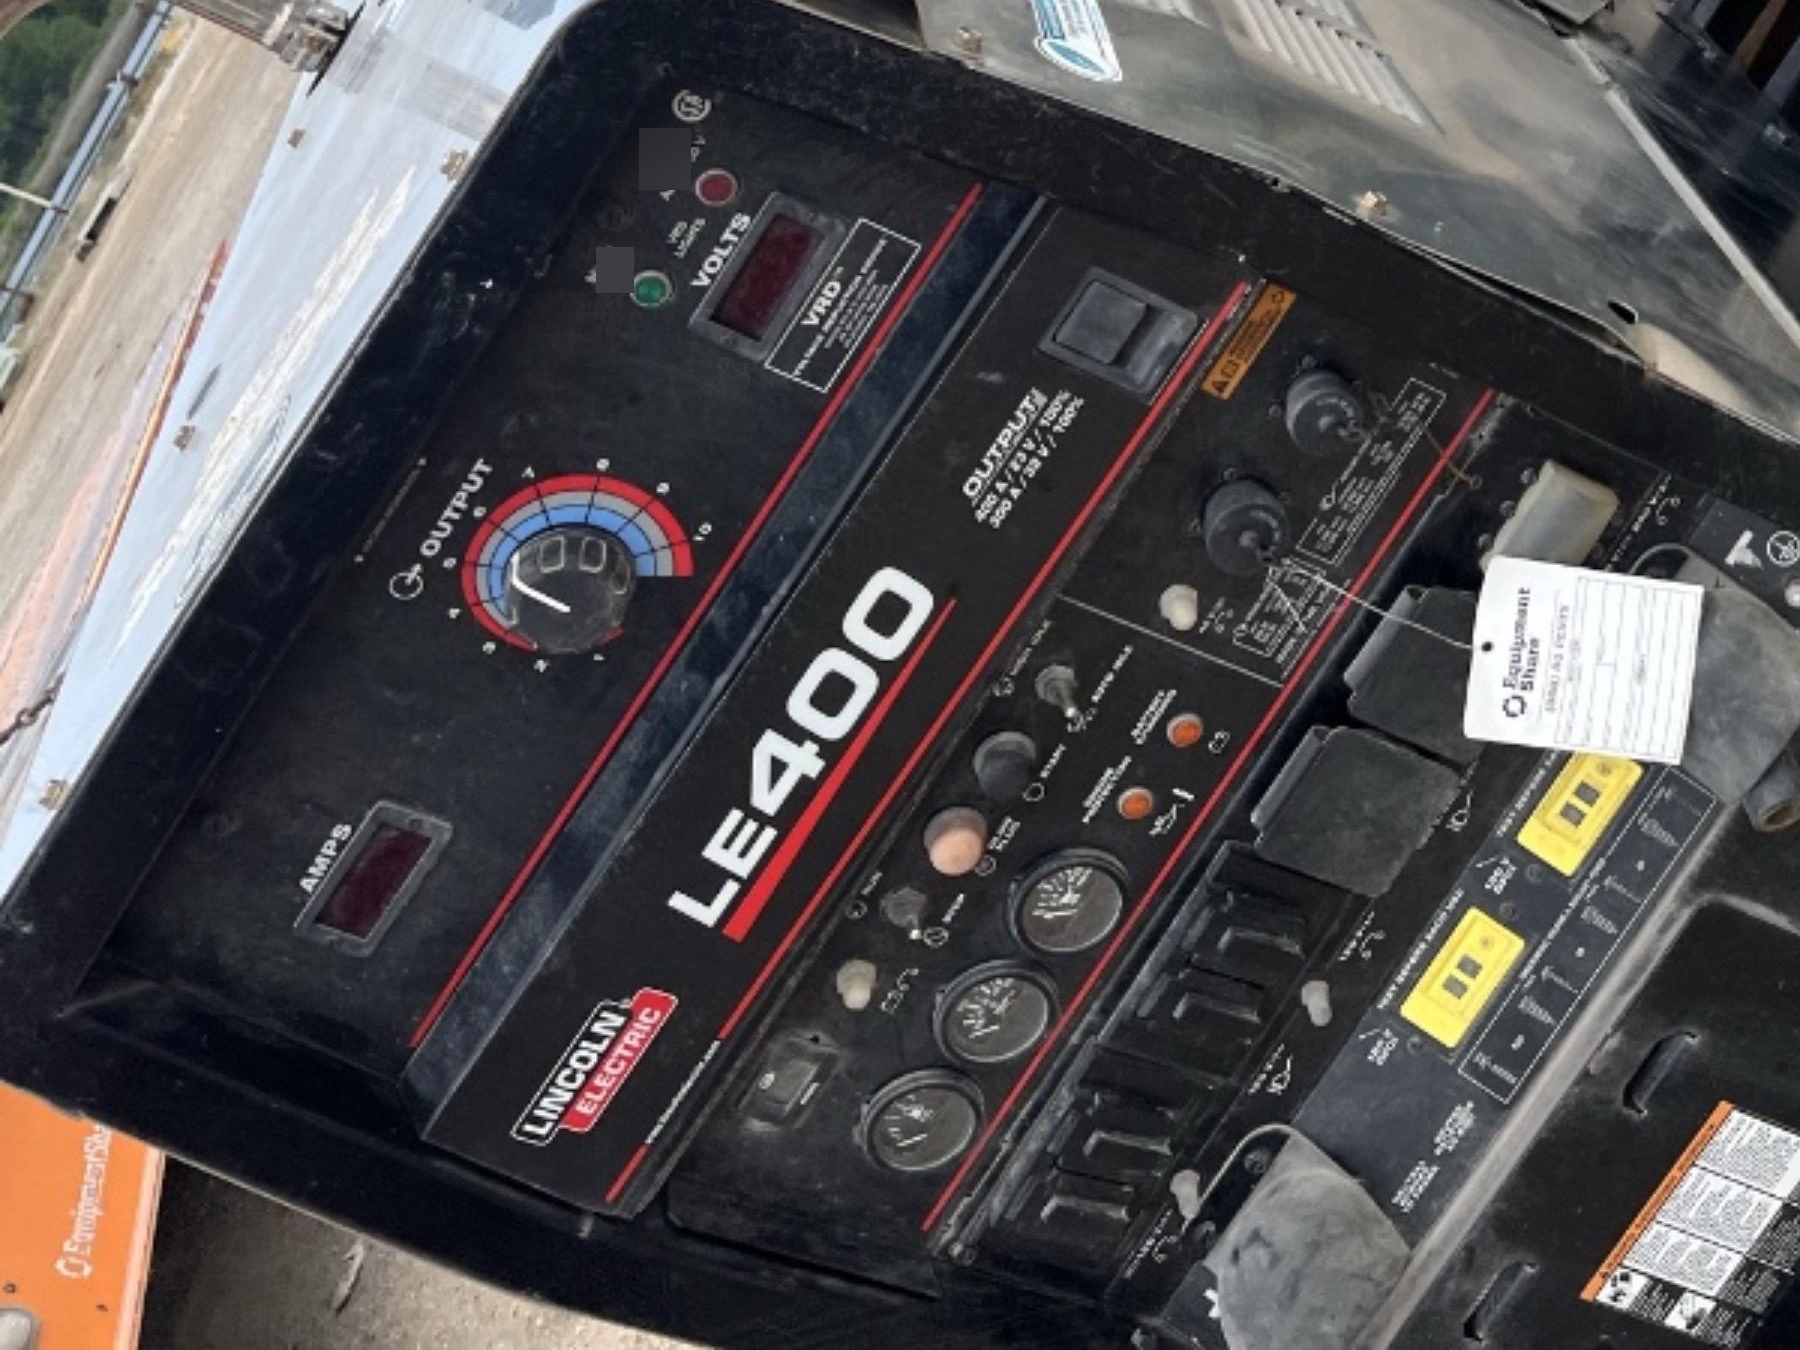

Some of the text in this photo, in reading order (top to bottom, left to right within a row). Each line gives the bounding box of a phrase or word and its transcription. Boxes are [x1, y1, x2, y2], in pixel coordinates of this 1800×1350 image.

[690, 209, 752, 290] VOLTS
[418, 457, 494, 560] OUTPUT
[1502, 587, 1531, 690] Equipment
[1519, 637, 1540, 691] Share
[666, 560, 939, 929] LE400
[298, 819, 355, 894] AMPS
[523, 1005, 626, 1142] LINCOLN
[575, 1004, 663, 1118] ELECTRIC
